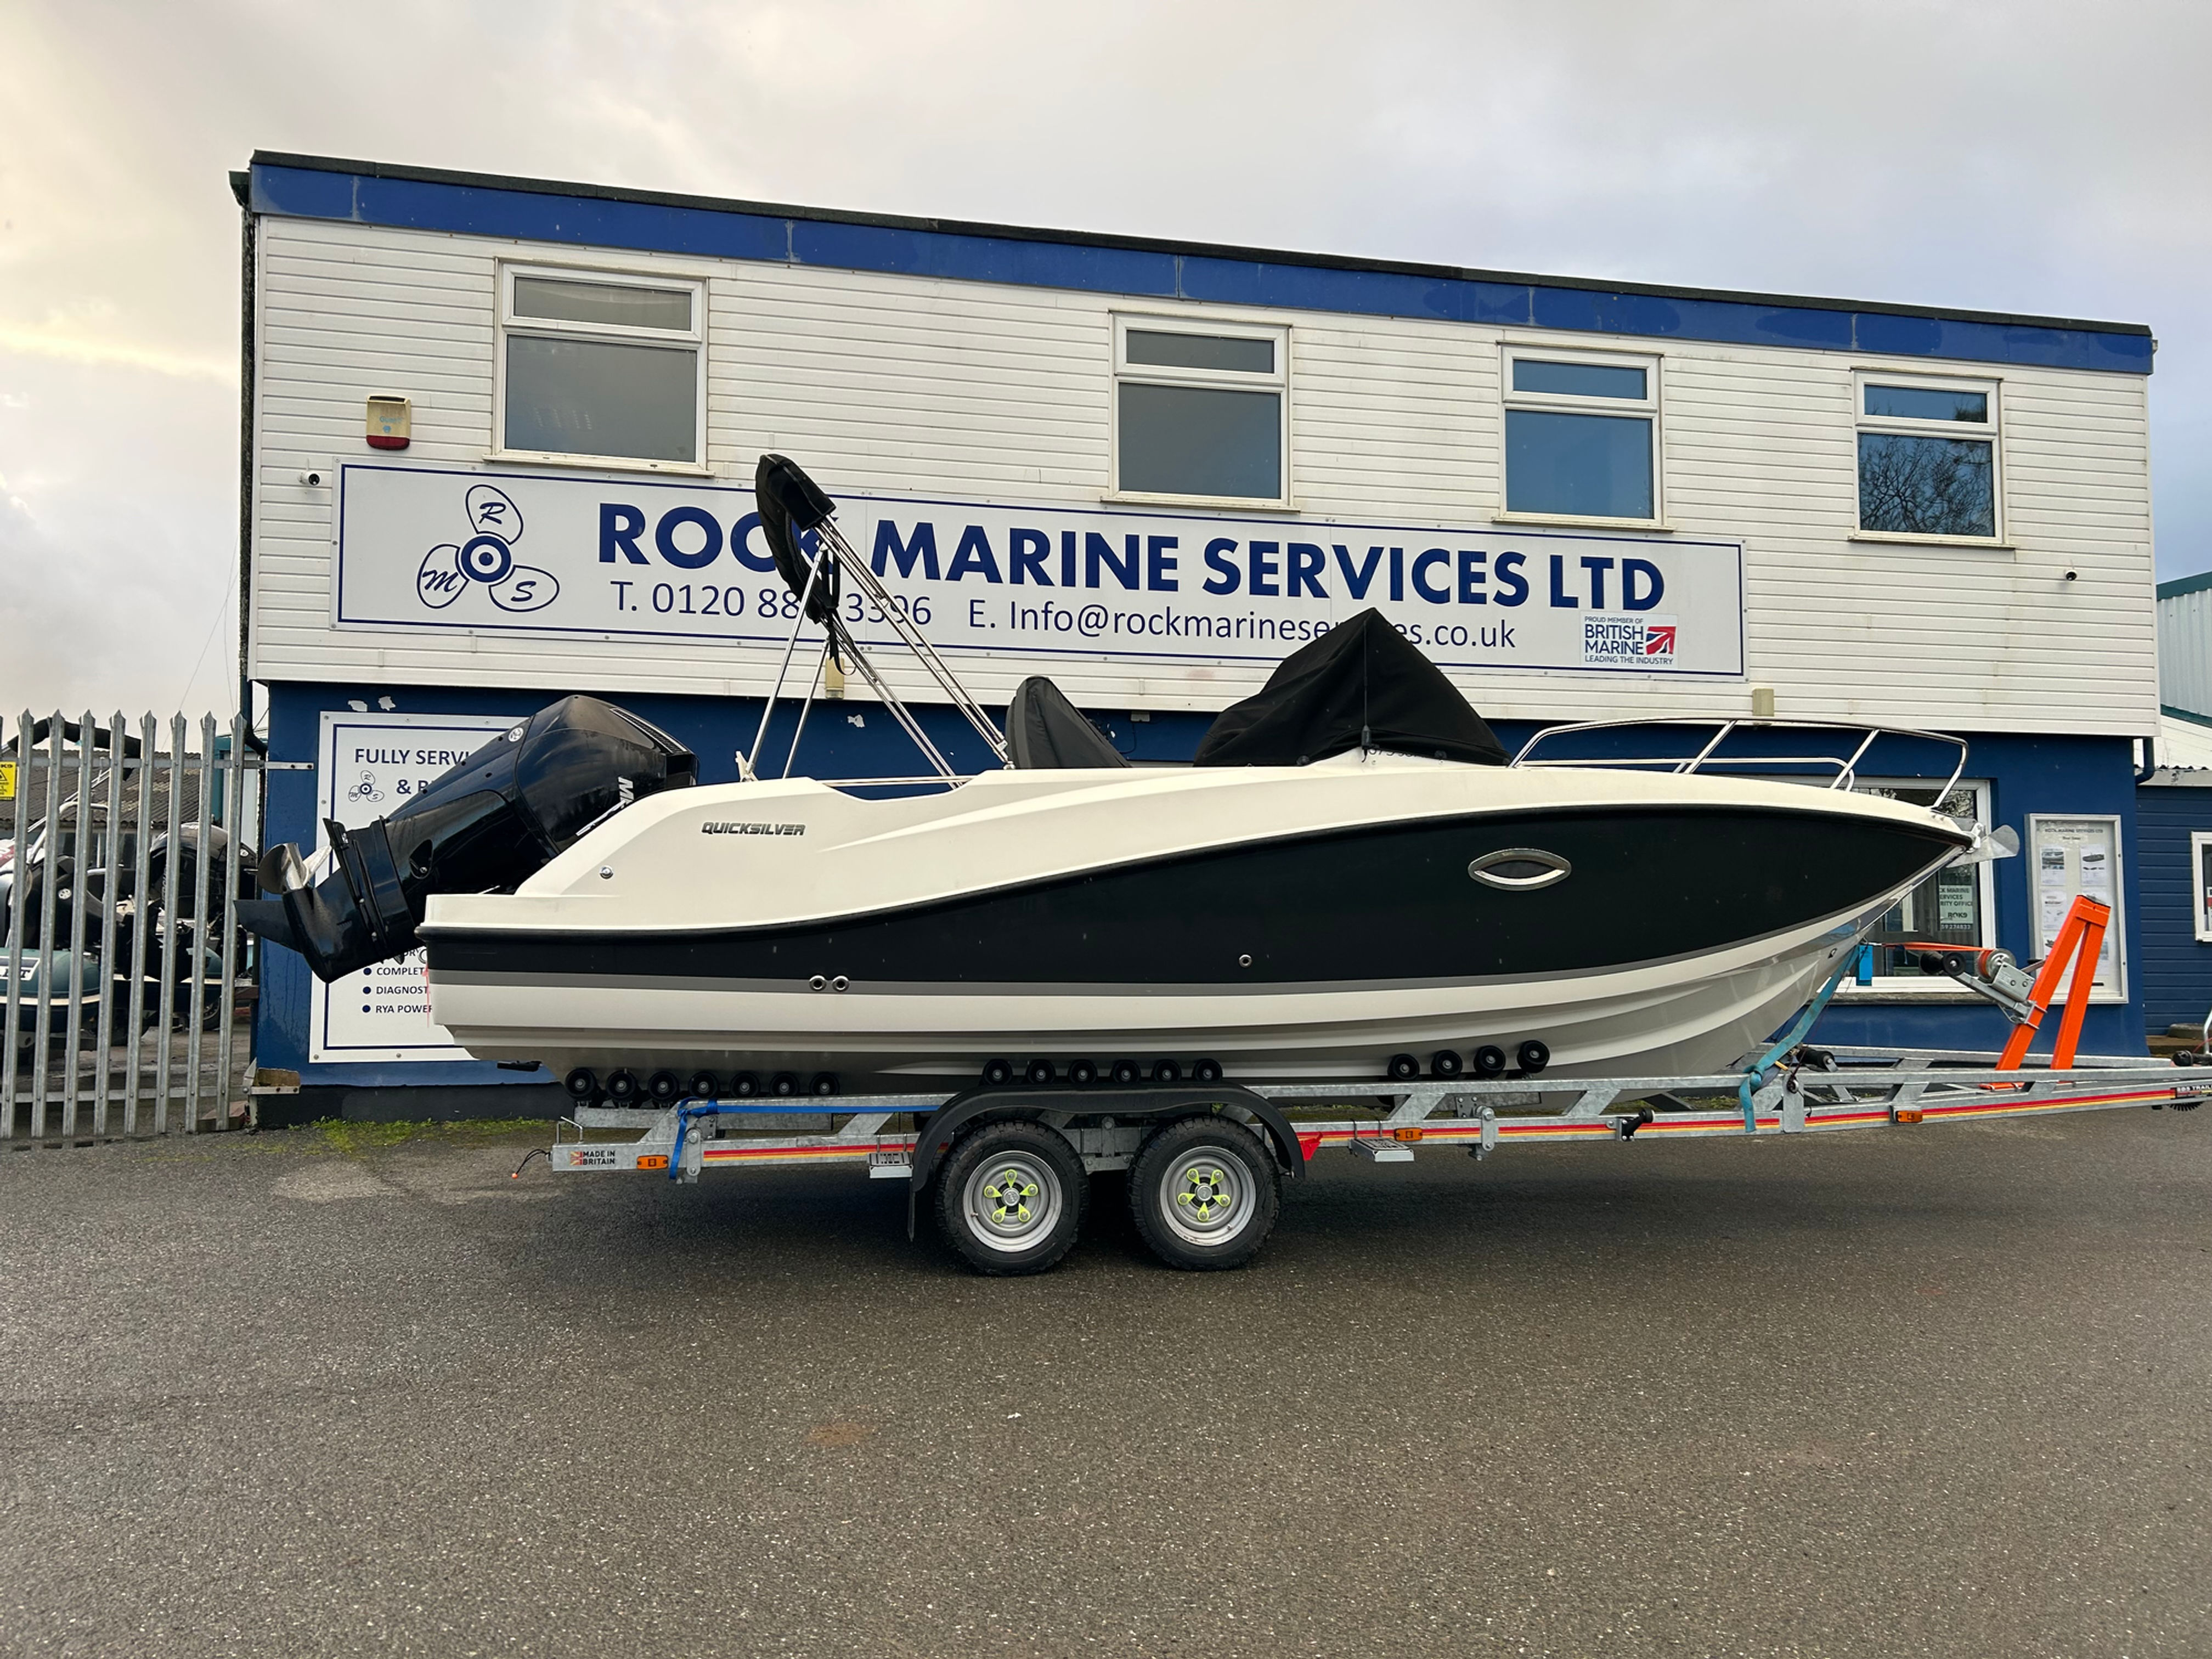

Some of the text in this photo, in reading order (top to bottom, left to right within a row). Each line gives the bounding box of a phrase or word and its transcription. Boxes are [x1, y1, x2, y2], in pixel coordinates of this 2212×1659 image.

[478, 502, 506, 525] R
[871, 520, 1178, 592] MARINE
[1202, 538, 1530, 607] SERVICES
[1550, 555, 1664, 611] LTD
[421, 568, 458, 593] M
[511, 581, 537, 602] S
[610, 581, 1516, 648] T. 0120 88 3396 E. Info@rockmarinesees.co.uk
[1585, 624, 1644, 640] BRITISH
[1585, 640, 1644, 654] MARINE
[355, 748, 410, 764] FULLY
[396, 780, 411, 794] &
[702, 822, 805, 836] QUICKSILVER
